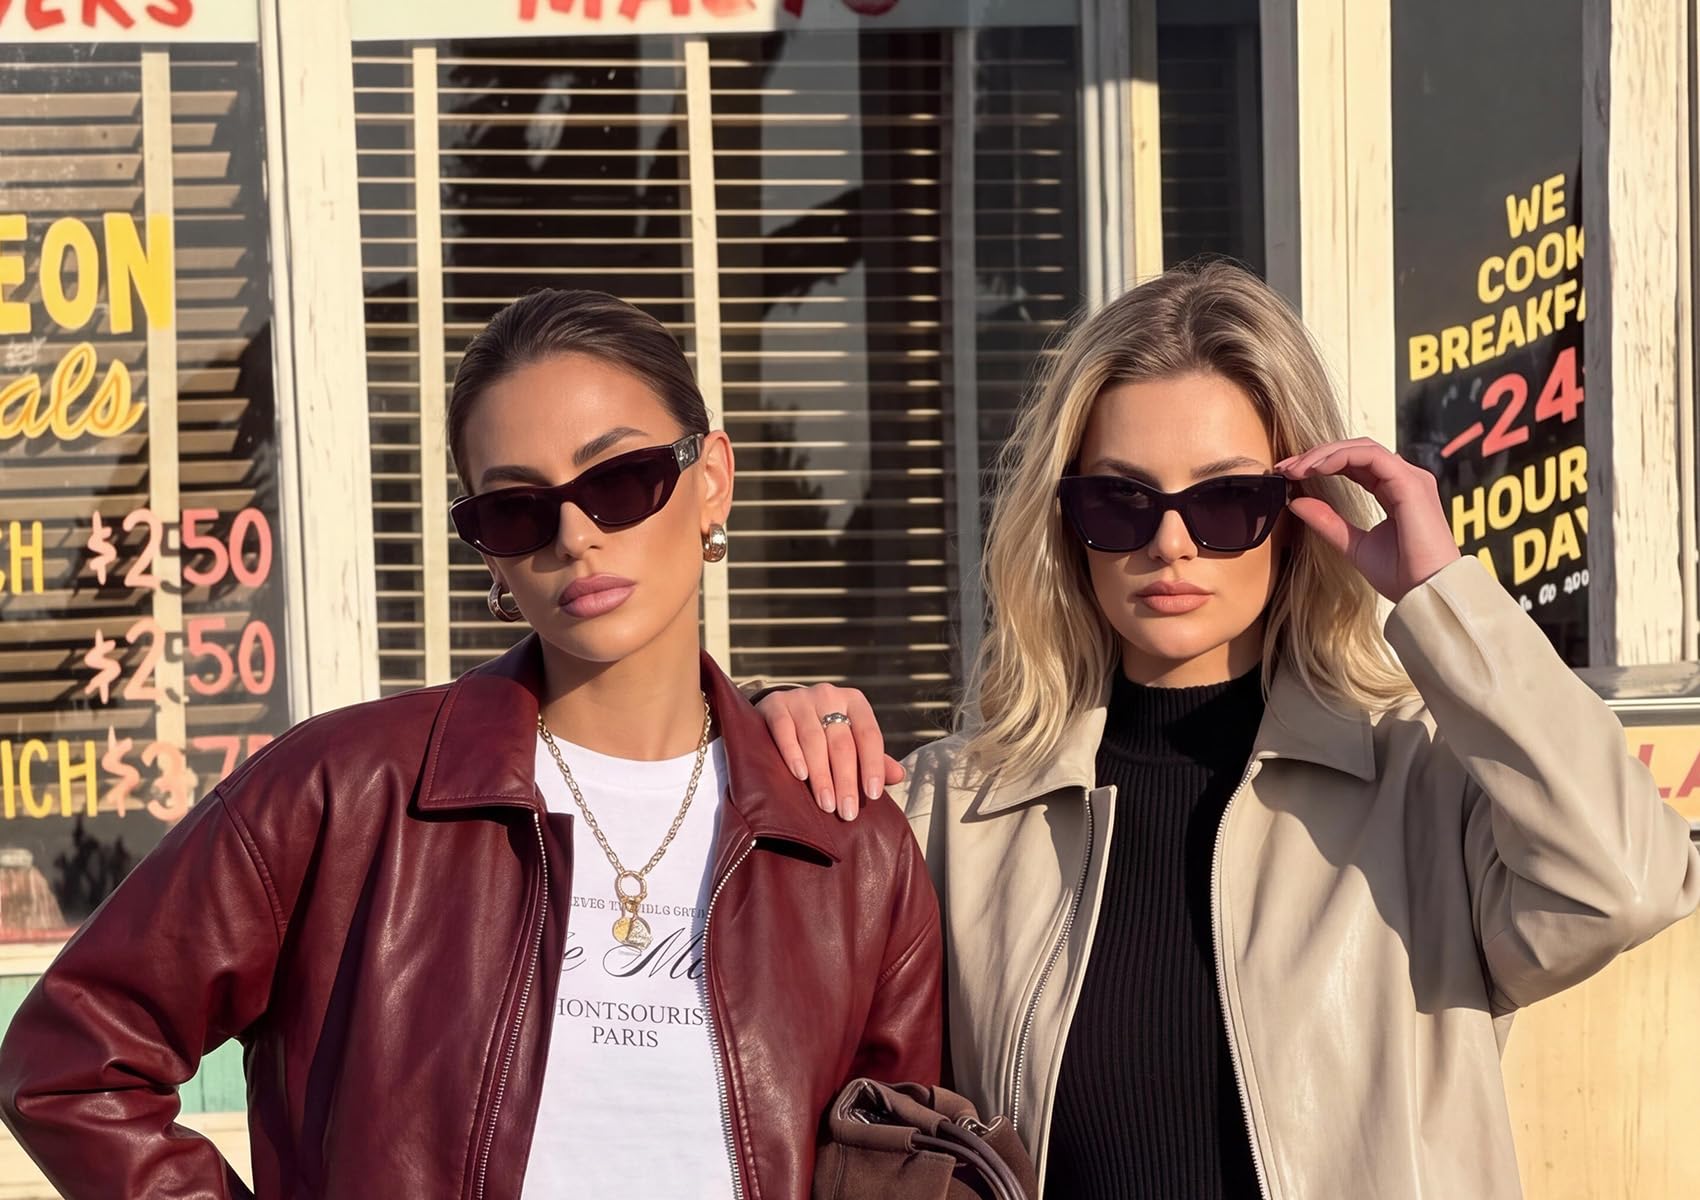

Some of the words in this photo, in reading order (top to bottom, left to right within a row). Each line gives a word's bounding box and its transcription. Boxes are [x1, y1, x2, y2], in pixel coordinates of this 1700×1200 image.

[1506, 174, 1566, 239] WE
[0, 213, 175, 334] EON
[1452, 446, 1588, 547] HOUR
[0, 521, 44, 595] H
[0, 739, 98, 819] ICH
[592, 1026, 659, 1048] PARIS
